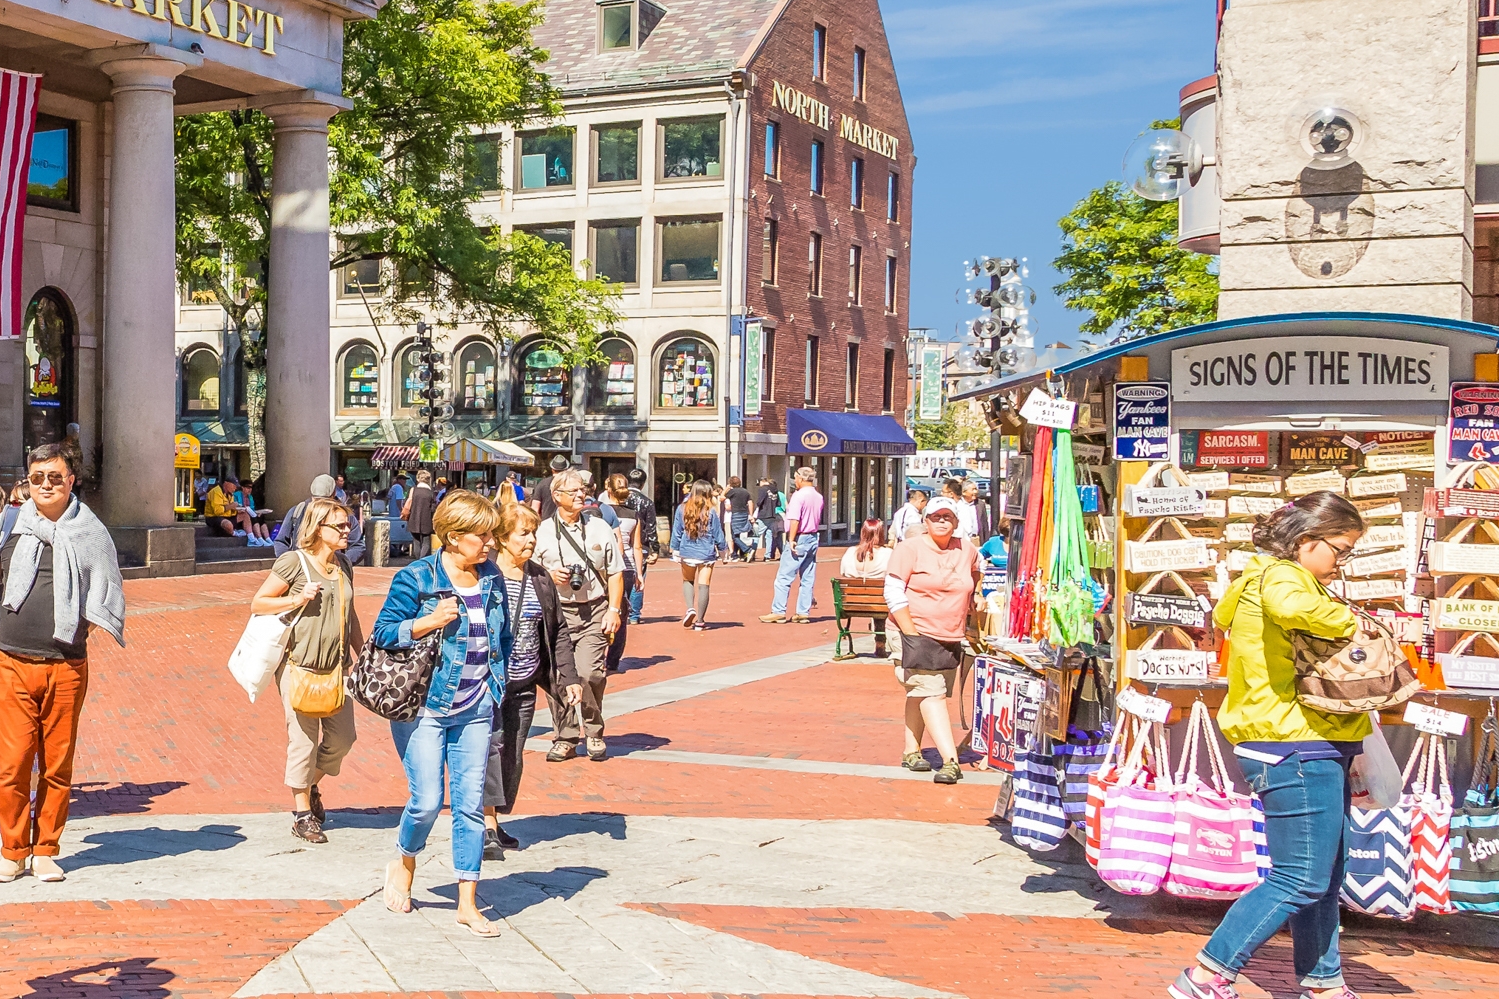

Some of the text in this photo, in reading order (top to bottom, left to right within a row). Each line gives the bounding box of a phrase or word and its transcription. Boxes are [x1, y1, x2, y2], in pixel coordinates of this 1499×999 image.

[772, 79, 899, 161] NORTH MARKET
[1189, 351, 1431, 387] SIGNS OF THE TIMES
[1050, 402, 1070, 410] BAGS
[1117, 401, 1167, 420] Yankees
[1453, 404, 1479, 418] RED
[1131, 417, 1154, 425] FAN
[1468, 419, 1494, 427] FAN
[1117, 427, 1168, 438] MAN CAVE
[1452, 428, 1481, 441] MAN
[1204, 435, 1261, 448] SARCASM.
[1290, 448, 1318, 460] MAN
[1319, 447, 1349, 460] CAVE
[1200, 456, 1235, 465] SERVICES
[1241, 456, 1265, 464] OFFER
[1359, 482, 1401, 493] SUNSHINE
[1138, 506, 1170, 514] Psycho
[1363, 532, 1404, 544] Is What It Is
[1134, 601, 1205, 624] Psycho Doggie
[1446, 603, 1493, 612] BANK OF
[1142, 659, 1204, 675] DOG IS NUTS!
[1451, 660, 1496, 671] MY SISTER
[1447, 671, 1486, 682] THE BEST
[1145, 697, 1162, 707] SALE
[1420, 705, 1451, 719] SALE
[992, 740, 1015, 762] SOX
[1196, 843, 1233, 857] BOSTON
